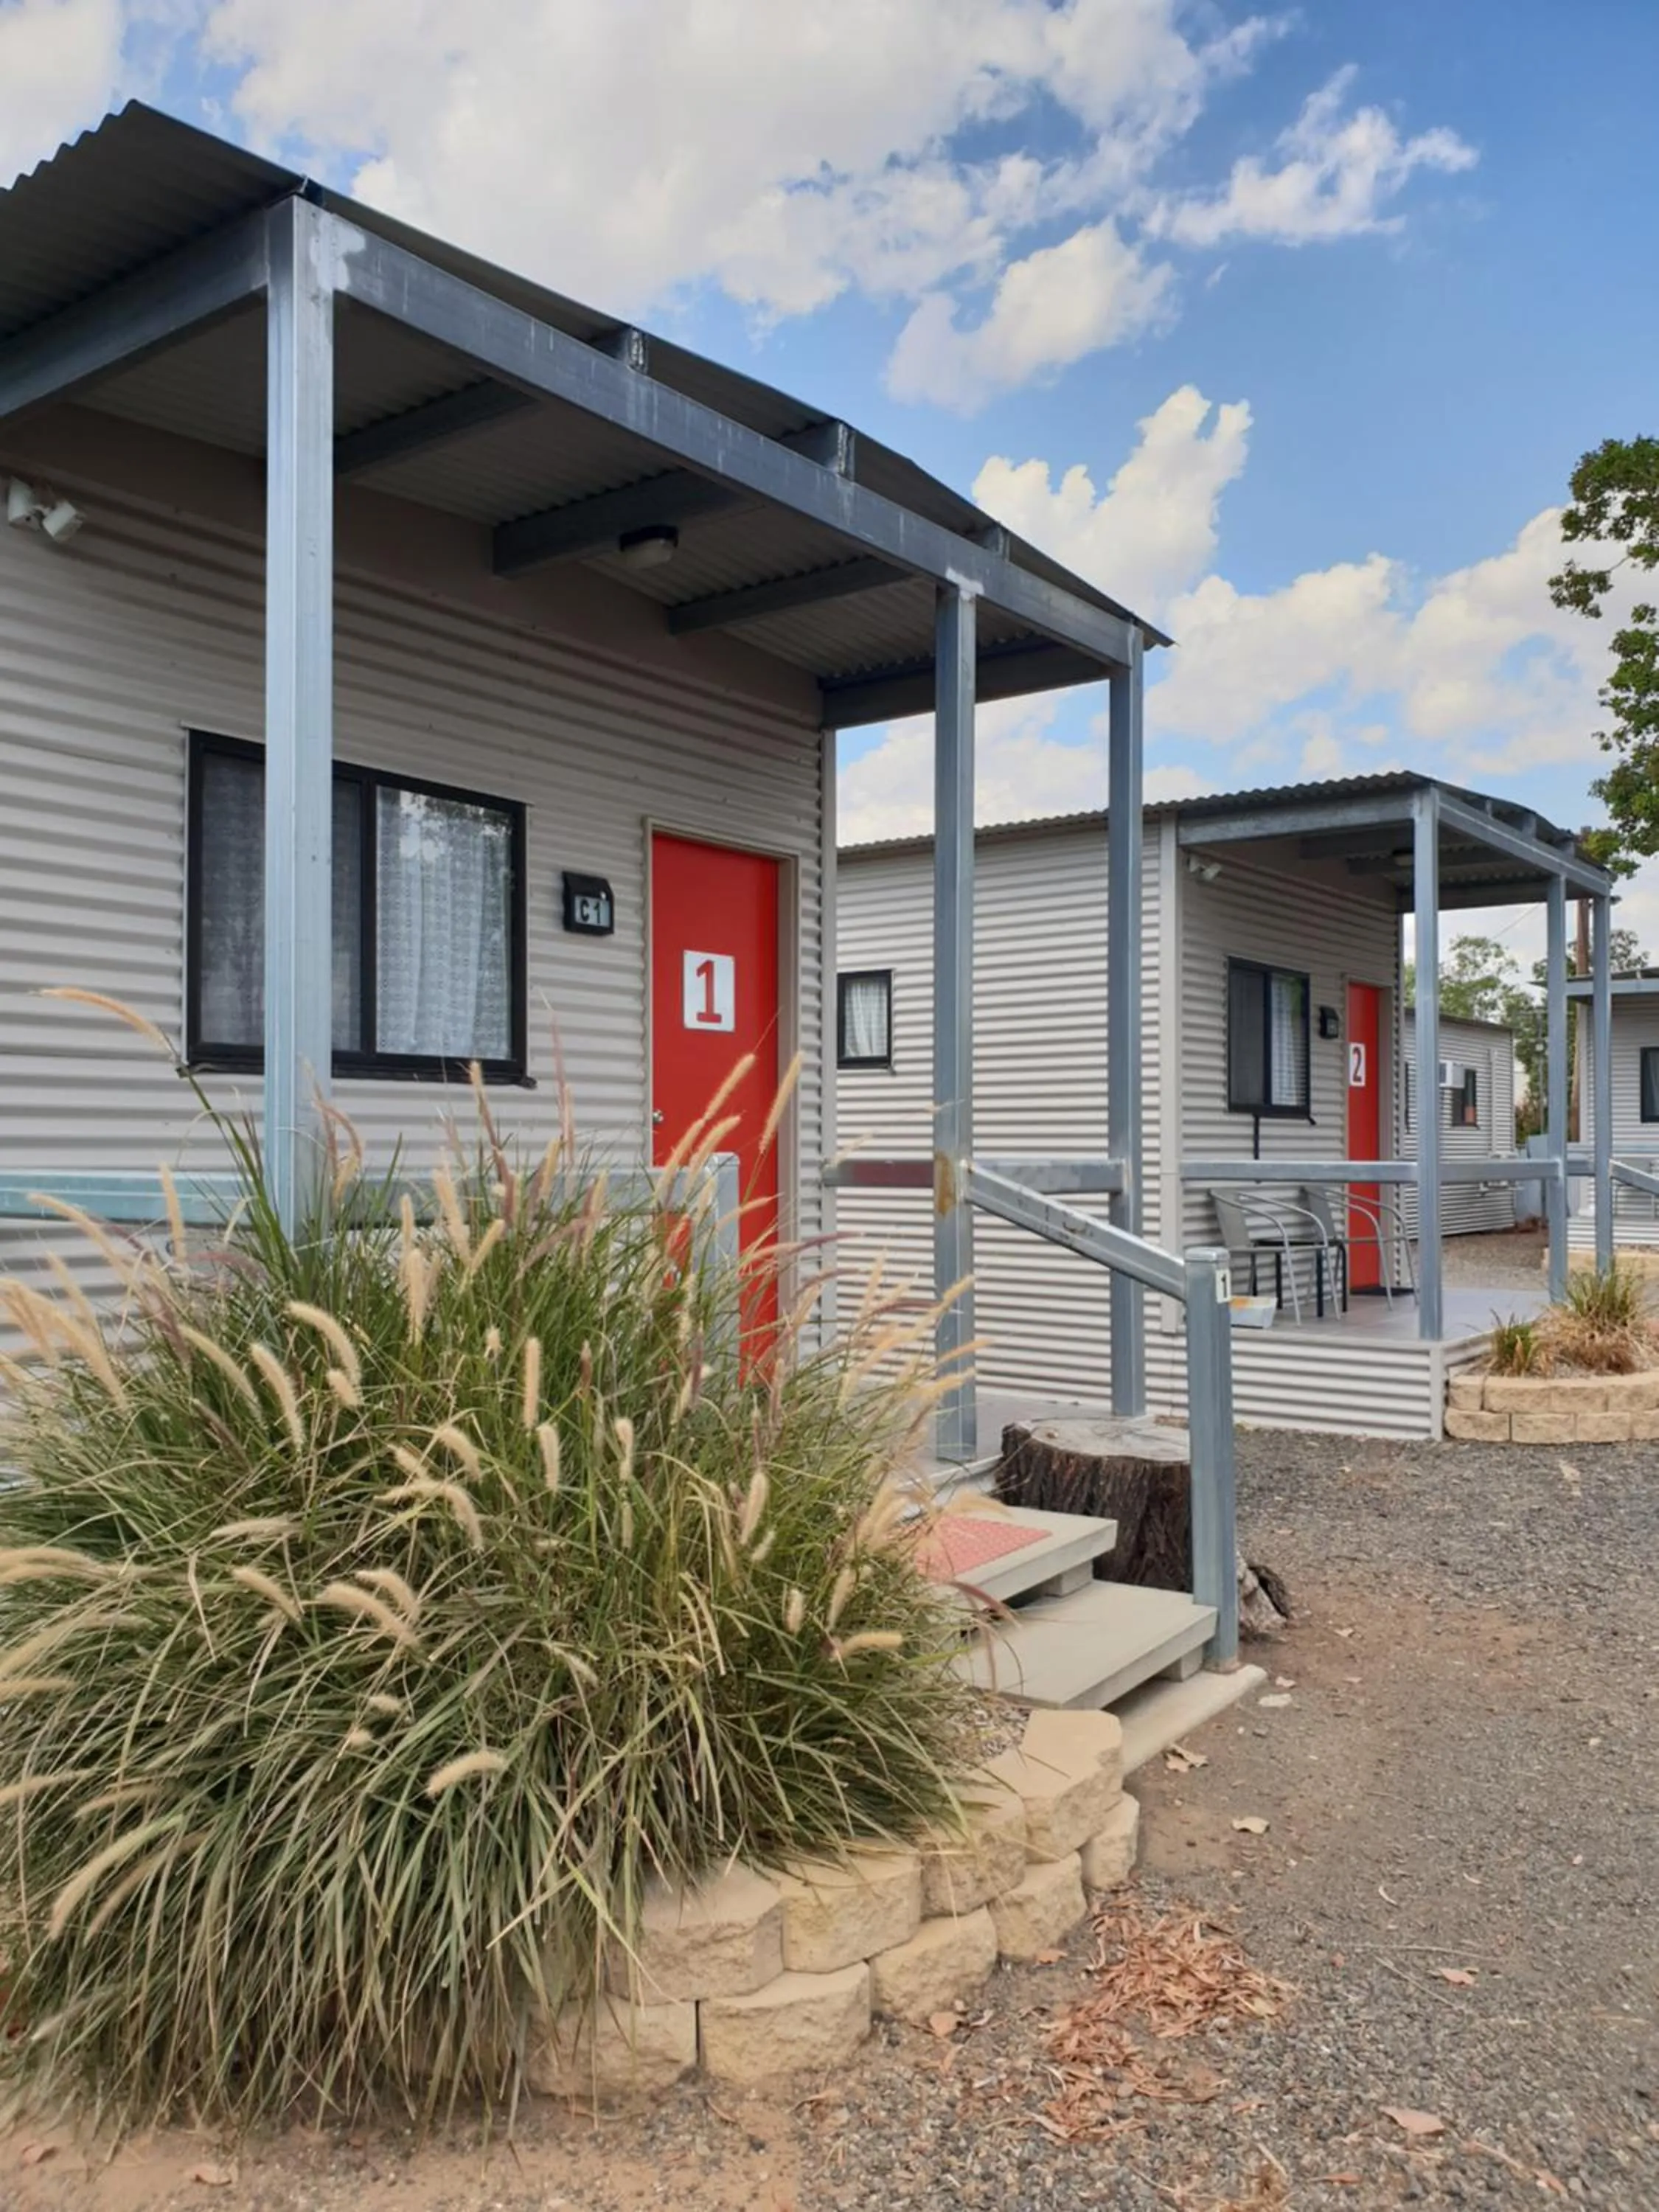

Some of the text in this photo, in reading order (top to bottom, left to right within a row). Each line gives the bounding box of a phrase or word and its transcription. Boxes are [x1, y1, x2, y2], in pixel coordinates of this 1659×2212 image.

[696, 960, 722, 1023] 1
[1352, 1046, 1362, 1082] 2
[1221, 1274, 1227, 1298] 1
